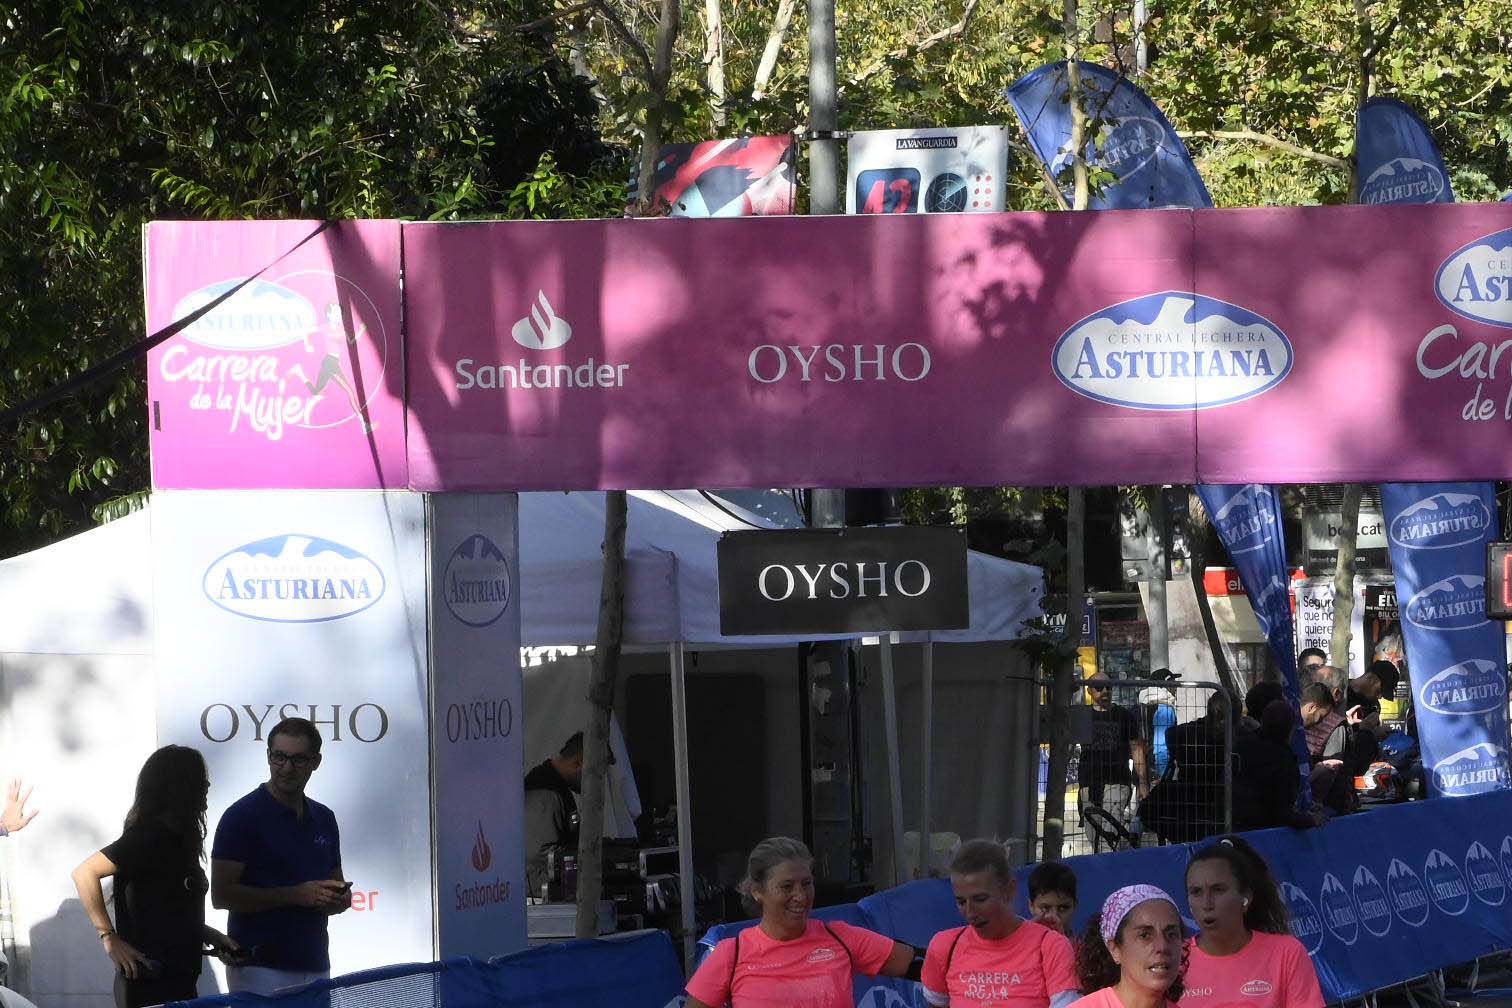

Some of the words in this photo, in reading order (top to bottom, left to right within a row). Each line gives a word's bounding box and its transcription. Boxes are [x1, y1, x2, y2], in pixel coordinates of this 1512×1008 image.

[908, 137, 957, 148] VANGUARDIA
[1107, 333, 1182, 345] CENTRAL
[1190, 331, 1266, 344] LECHERA
[160, 344, 279, 383] Carrera
[455, 357, 629, 390] Santander
[747, 342, 932, 384] OYSHO
[1071, 336, 1275, 380] ASTURIANA
[190, 384, 211, 410] de
[216, 383, 232, 410] la
[229, 378, 323, 441] Mujer
[1461, 383, 1496, 422] de
[219, 567, 373, 600] ASTURIANA
[451, 572, 507, 605] ASTURIANA
[758, 559, 932, 601] OYSHO
[1304, 612, 1320, 626] que
[446, 698, 512, 744] OYSHO
[454, 879, 512, 913] Santander
[959, 972, 1022, 985] CARRERA
